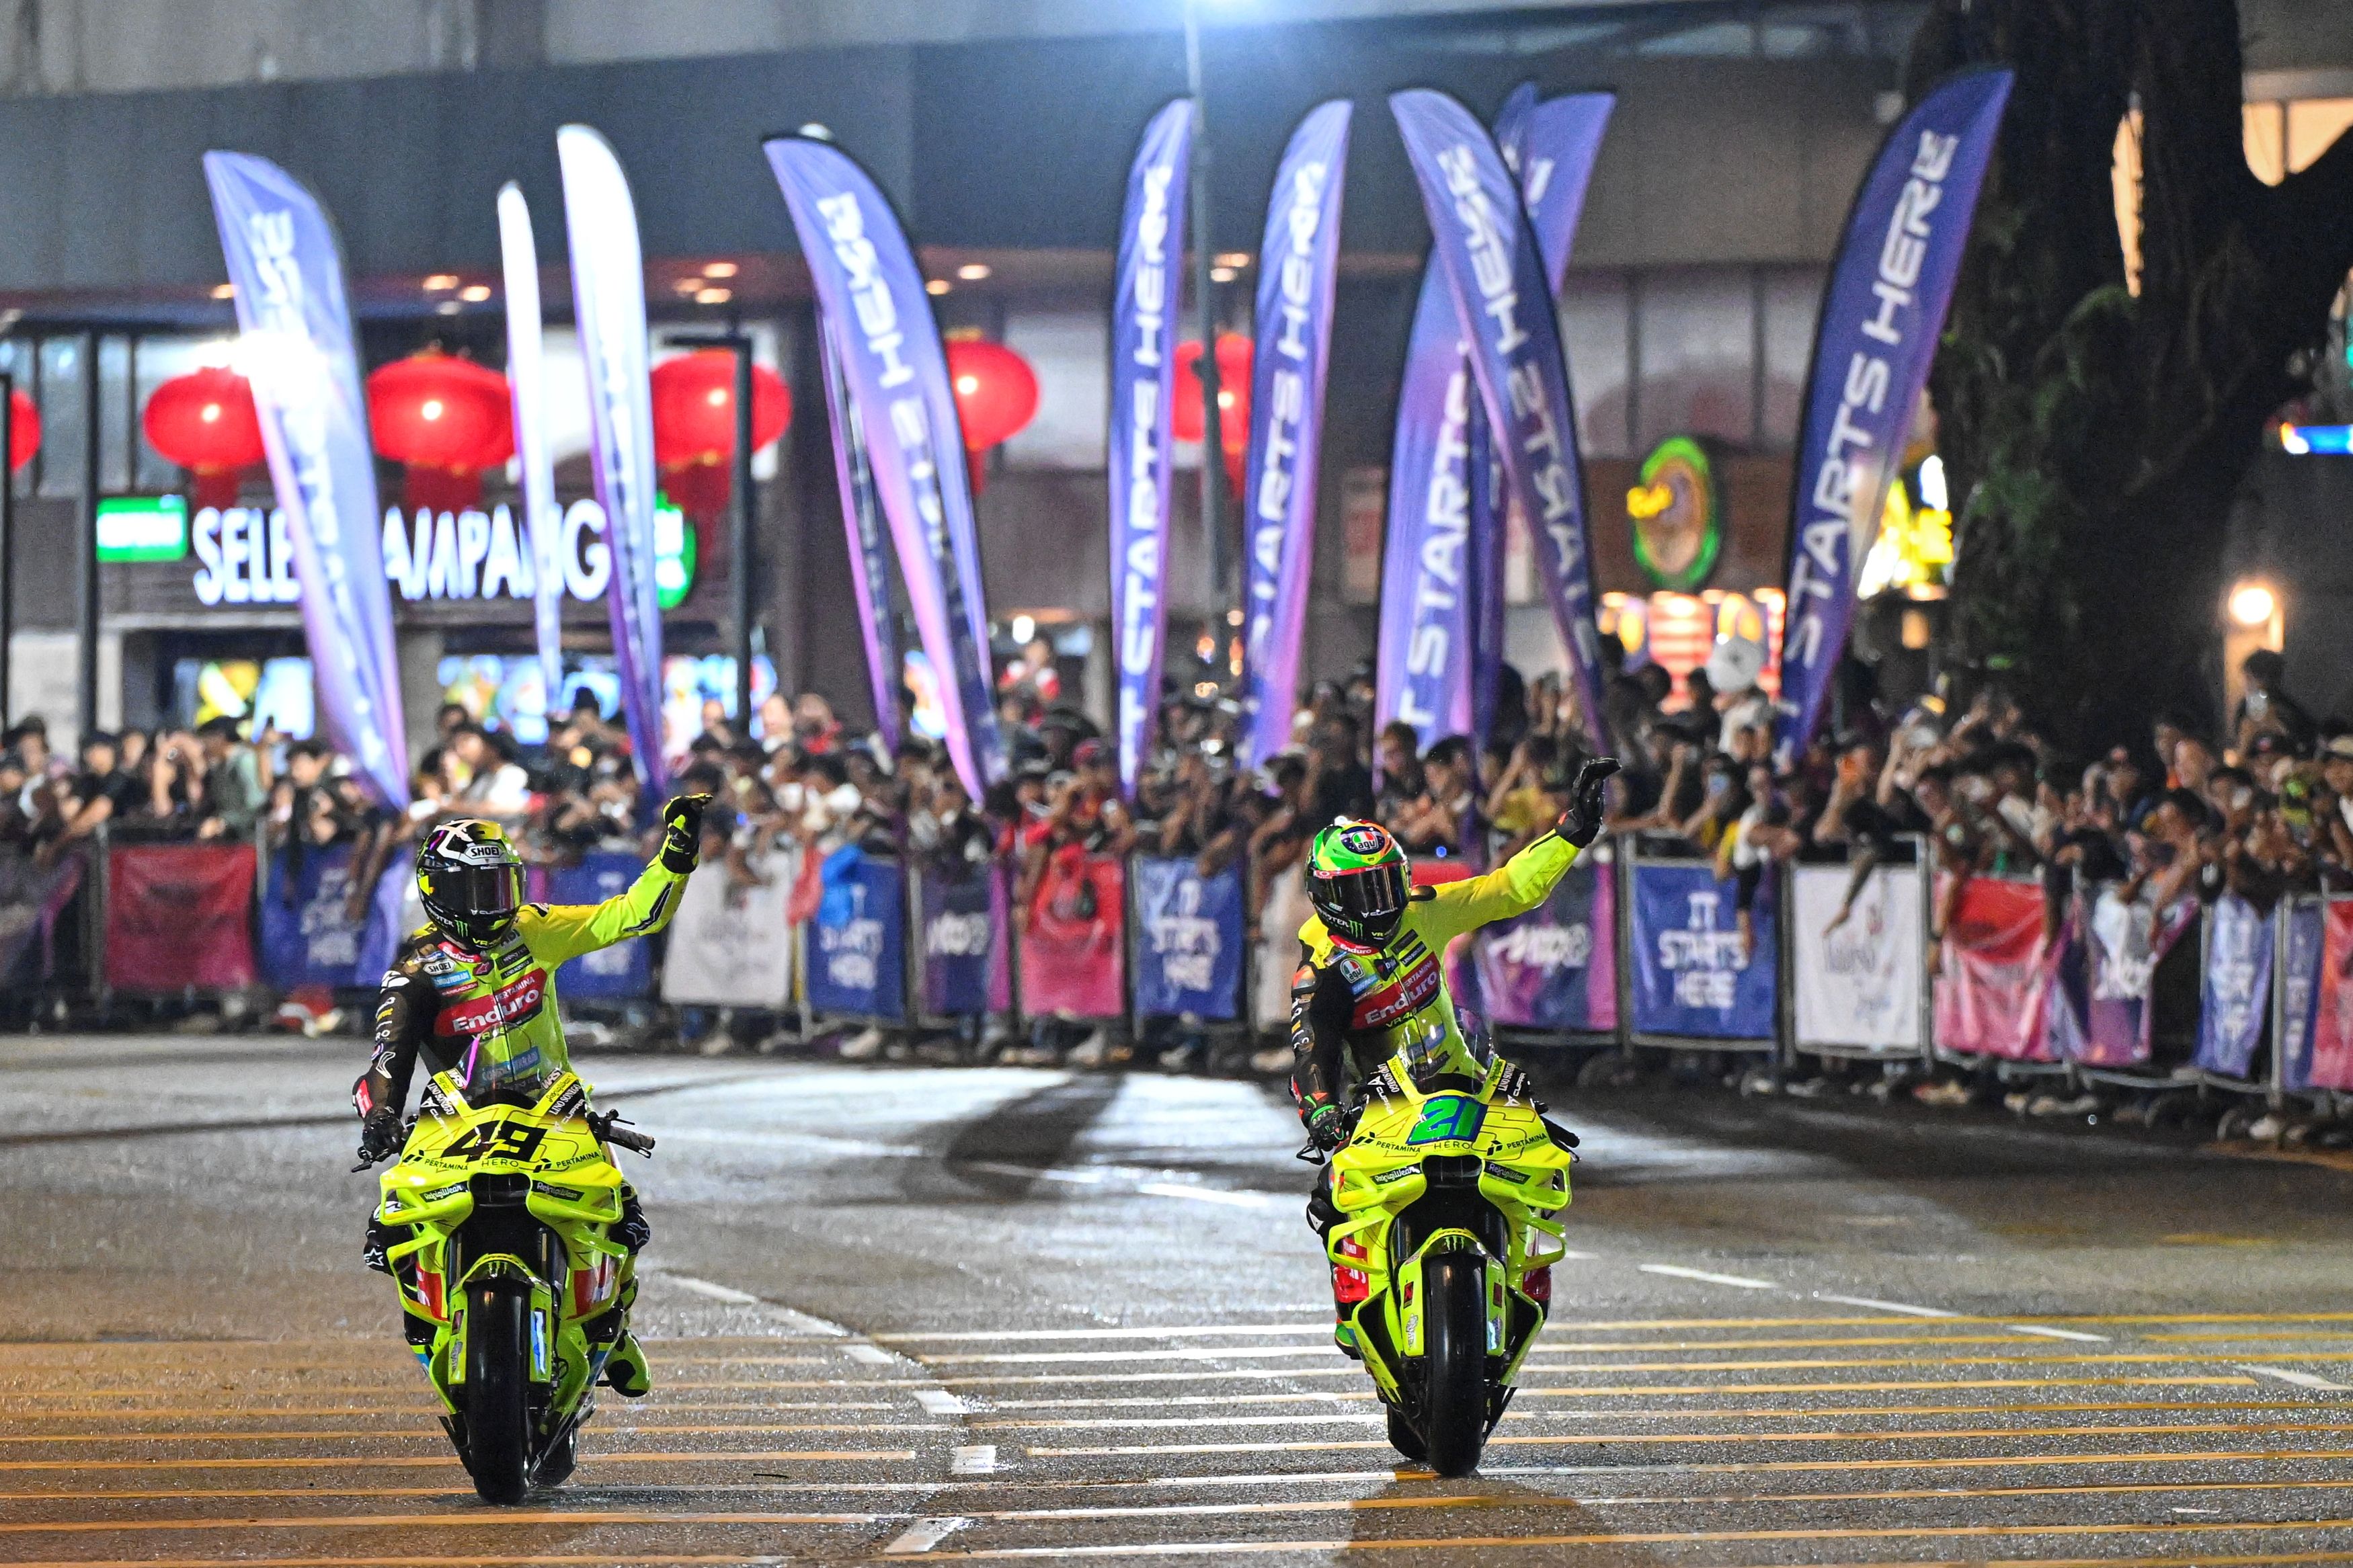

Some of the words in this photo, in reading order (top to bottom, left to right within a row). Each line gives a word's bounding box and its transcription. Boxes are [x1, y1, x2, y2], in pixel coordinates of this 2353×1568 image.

[1862, 129, 1960, 345] HERE
[471, 847, 500, 856] SHOEI
[1358, 839, 1375, 850] agv
[428, 962, 451, 973] SHOEI
[1349, 969, 1362, 980] agv
[1365, 972, 1438, 1024] Enduro
[452, 989, 539, 1032] Enduro
[549, 1100, 565, 1115] LINO
[561, 1098, 587, 1124] CUPRA
[1408, 1096, 1488, 1145] 21
[441, 1120, 549, 1163] 49
[1376, 1141, 1421, 1153] PERTAMINA
[1434, 1141, 1470, 1150] HERO
[1507, 1132, 1547, 1149] PERTAMINA
[424, 1159, 469, 1171] PERTAMINA
[481, 1158, 519, 1167] HERO
[556, 1151, 600, 1167] PERTAMINA
